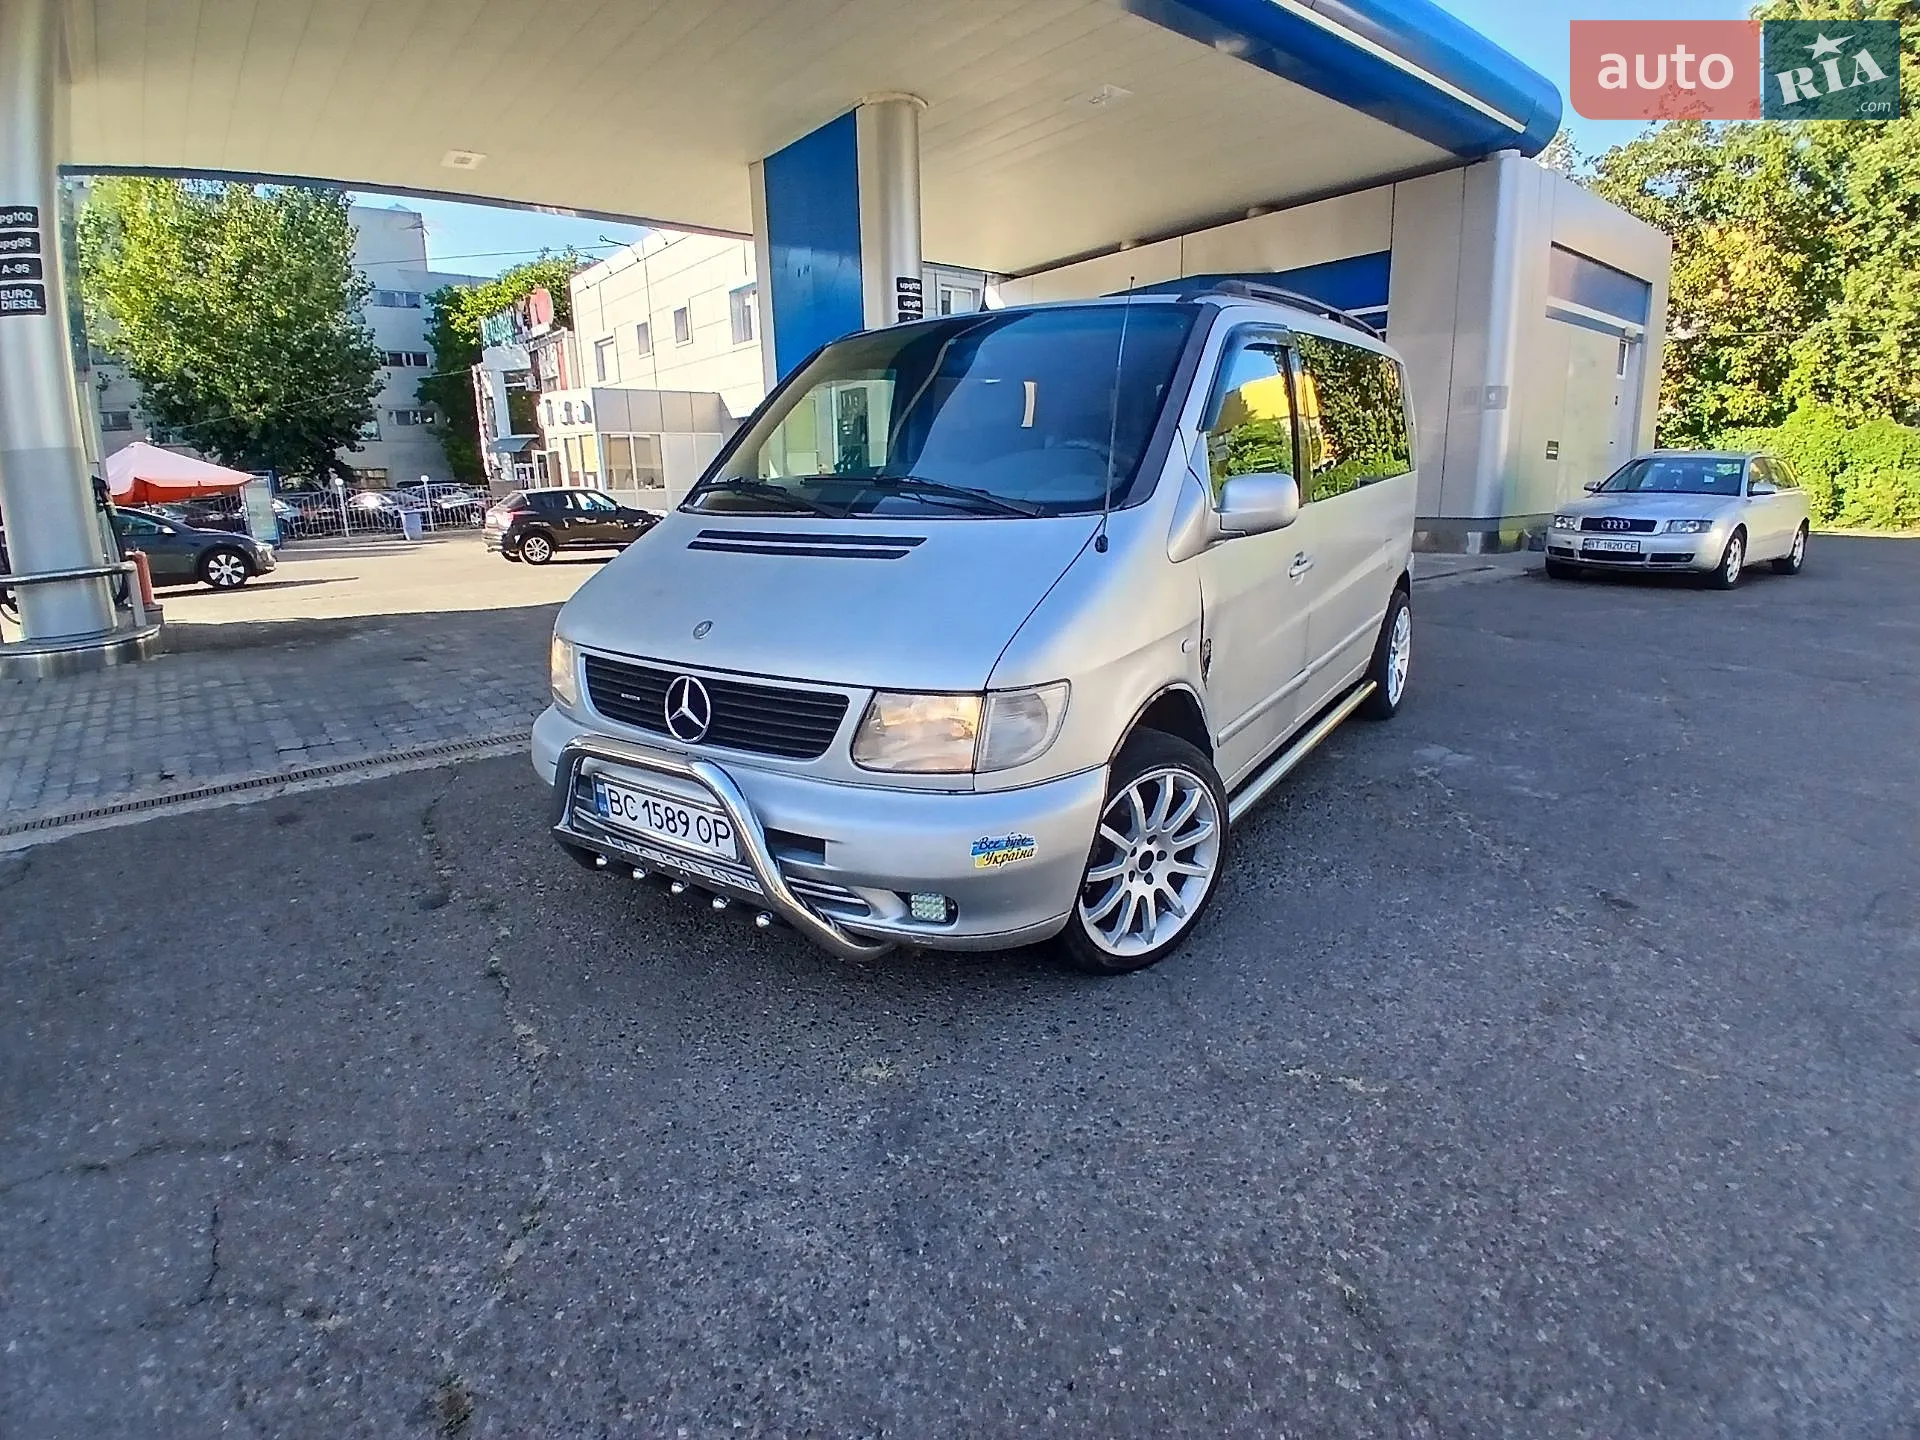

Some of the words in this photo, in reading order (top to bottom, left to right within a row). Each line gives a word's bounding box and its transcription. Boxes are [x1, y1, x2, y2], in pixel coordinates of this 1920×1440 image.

[0, 212, 33, 224] pg100
[2, 264, 30, 274] A-95
[0, 289, 33, 300] EURO
[1, 300, 42, 310] DIESEL
[1624, 542, 1638, 551] CE
[608, 788, 639, 822] BC
[641, 799, 691, 838] 1589
[696, 814, 731, 848] OP
